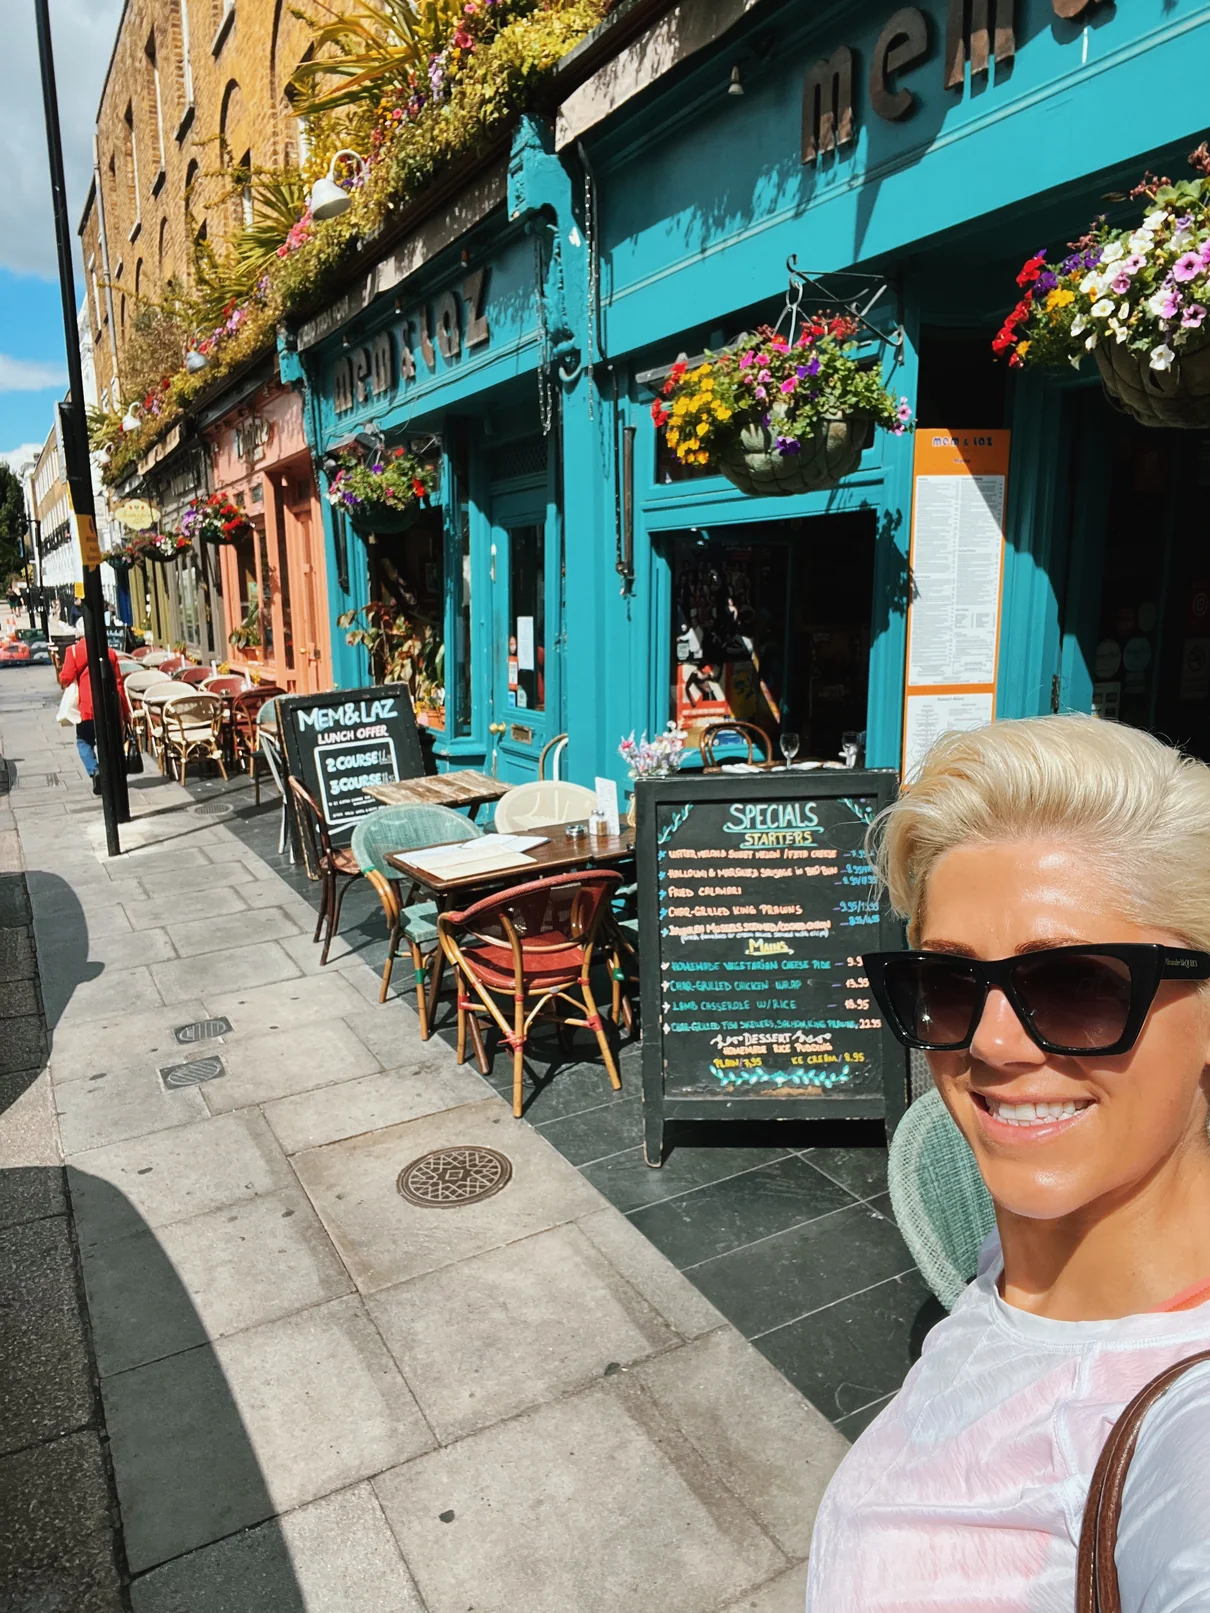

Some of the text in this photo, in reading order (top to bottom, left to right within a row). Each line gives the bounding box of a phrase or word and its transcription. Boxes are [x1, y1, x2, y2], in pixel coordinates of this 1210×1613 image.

[932, 436, 960, 447] mem
[297, 698, 398, 732] MEM&LAZ
[317, 724, 389, 745] LUNCH OFFER
[325, 757, 337, 773] 2
[336, 750, 379, 770] COURSE
[329, 779, 341, 795] 3
[339, 772, 382, 792] COURSE
[727, 802, 819, 830] SPECIALS
[744, 831, 813, 846] STARTERS
[668, 886, 742, 898] FRIED CALAMARI
[732, 905, 757, 915] KING
[758, 904, 804, 916] PRAWNS
[748, 938, 788, 952] MAINS
[671, 961, 720, 972] HOMEMADE
[781, 960, 809, 970] CHEESE
[846, 955, 863, 966] 9.9
[669, 980, 732, 991] CHAR-GRILLED
[734, 979, 769, 991] CHICKEN
[775, 980, 802, 990] WRAP
[672, 1001, 698, 1011] LAMB
[700, 1000, 750, 1012] CASSEROLE
[756, 998, 797, 1010] W/RICE
[743, 1032, 792, 1045] DESSERT
[723, 1042, 833, 1056] HOMEMADE RICE PUDDING
